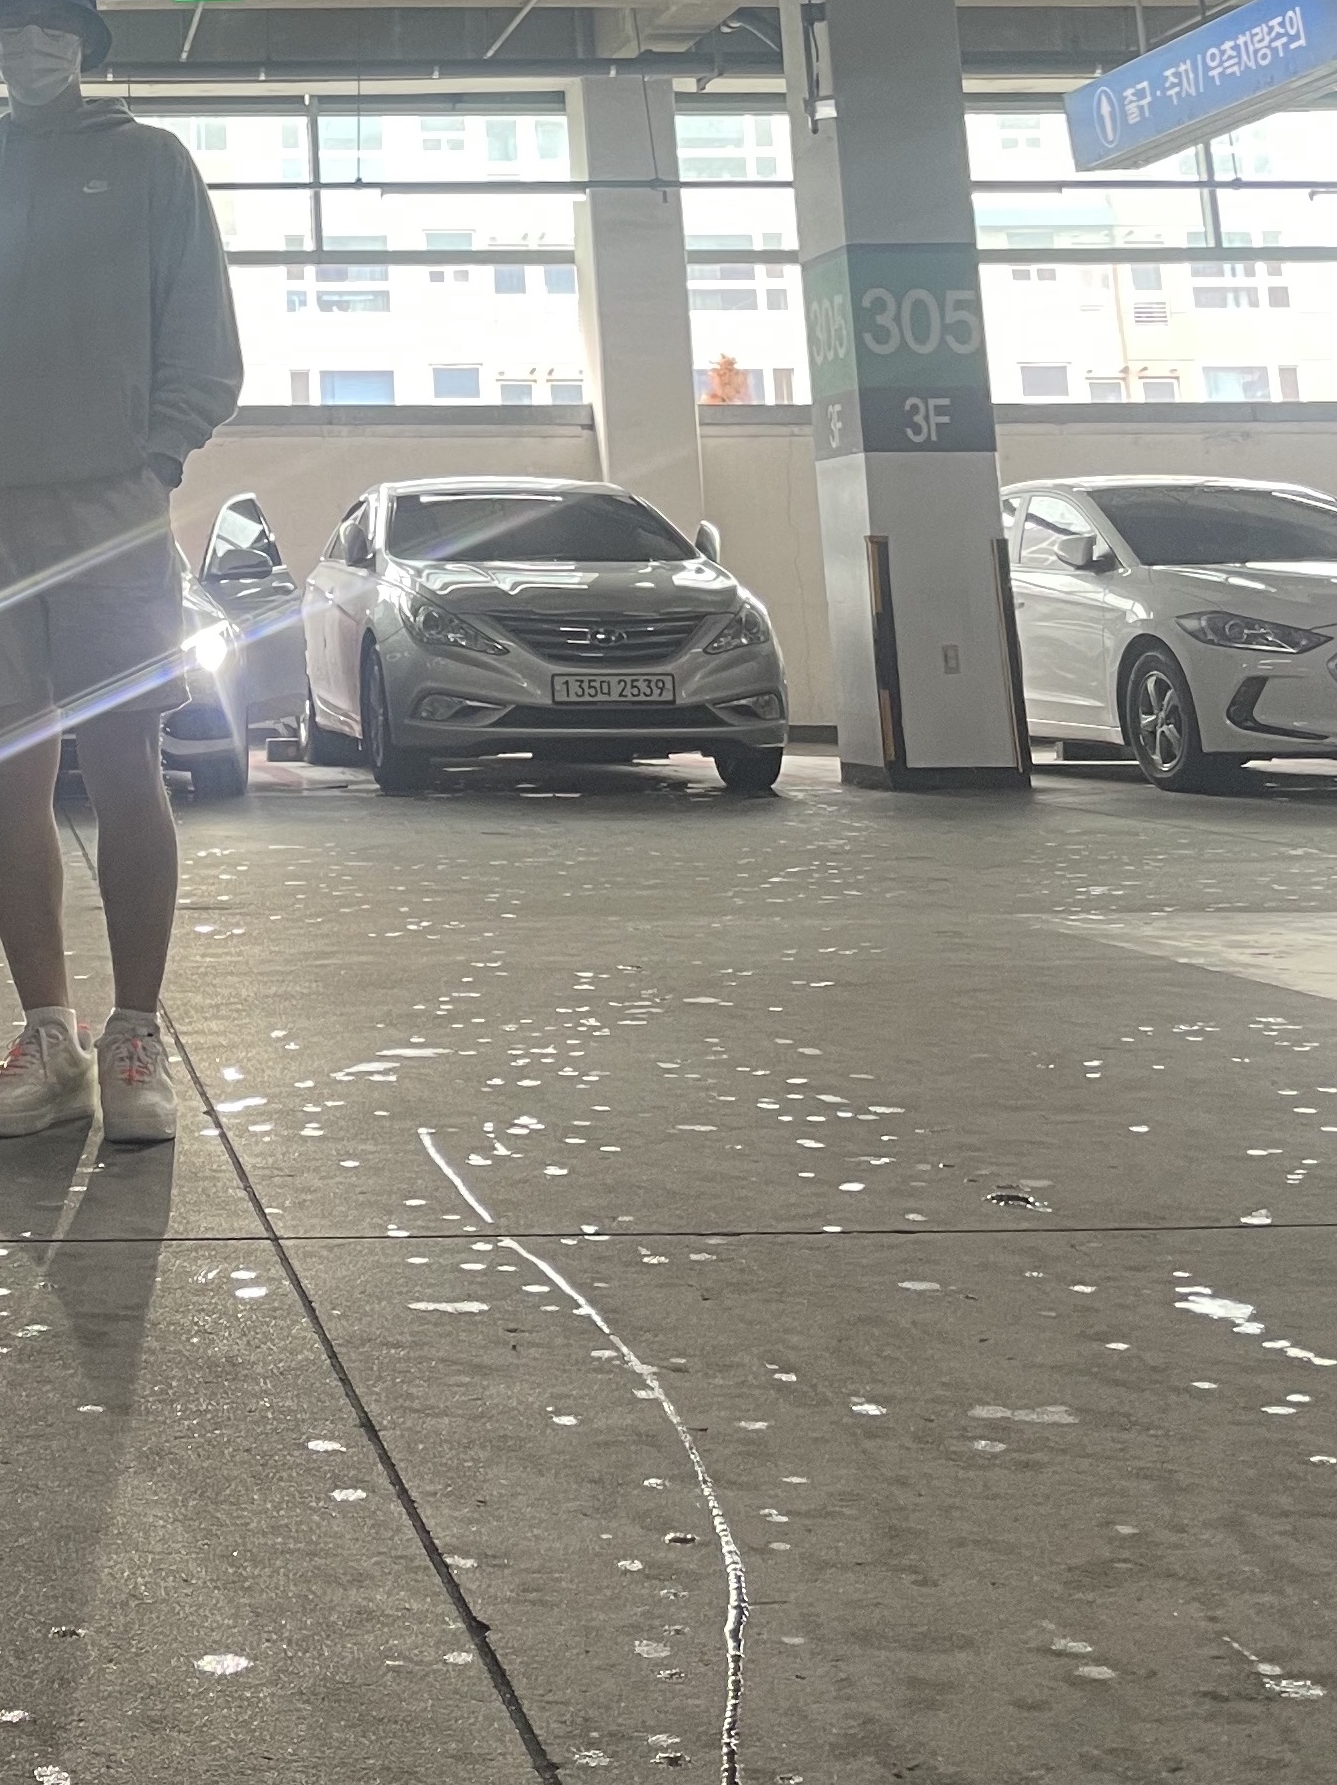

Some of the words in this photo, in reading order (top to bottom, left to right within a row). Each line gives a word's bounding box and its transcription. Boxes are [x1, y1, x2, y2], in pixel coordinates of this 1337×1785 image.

[1122, 80, 1153, 125] 출구
[1163, 59, 1197, 106] 주차
[1205, 6, 1307, 86] 우측차량주의
[811, 293, 847, 365] 305
[862, 287, 983, 356] 305
[827, 403, 843, 449] 3F
[904, 395, 952, 444] 3F
[617, 678, 665, 698] 2539
